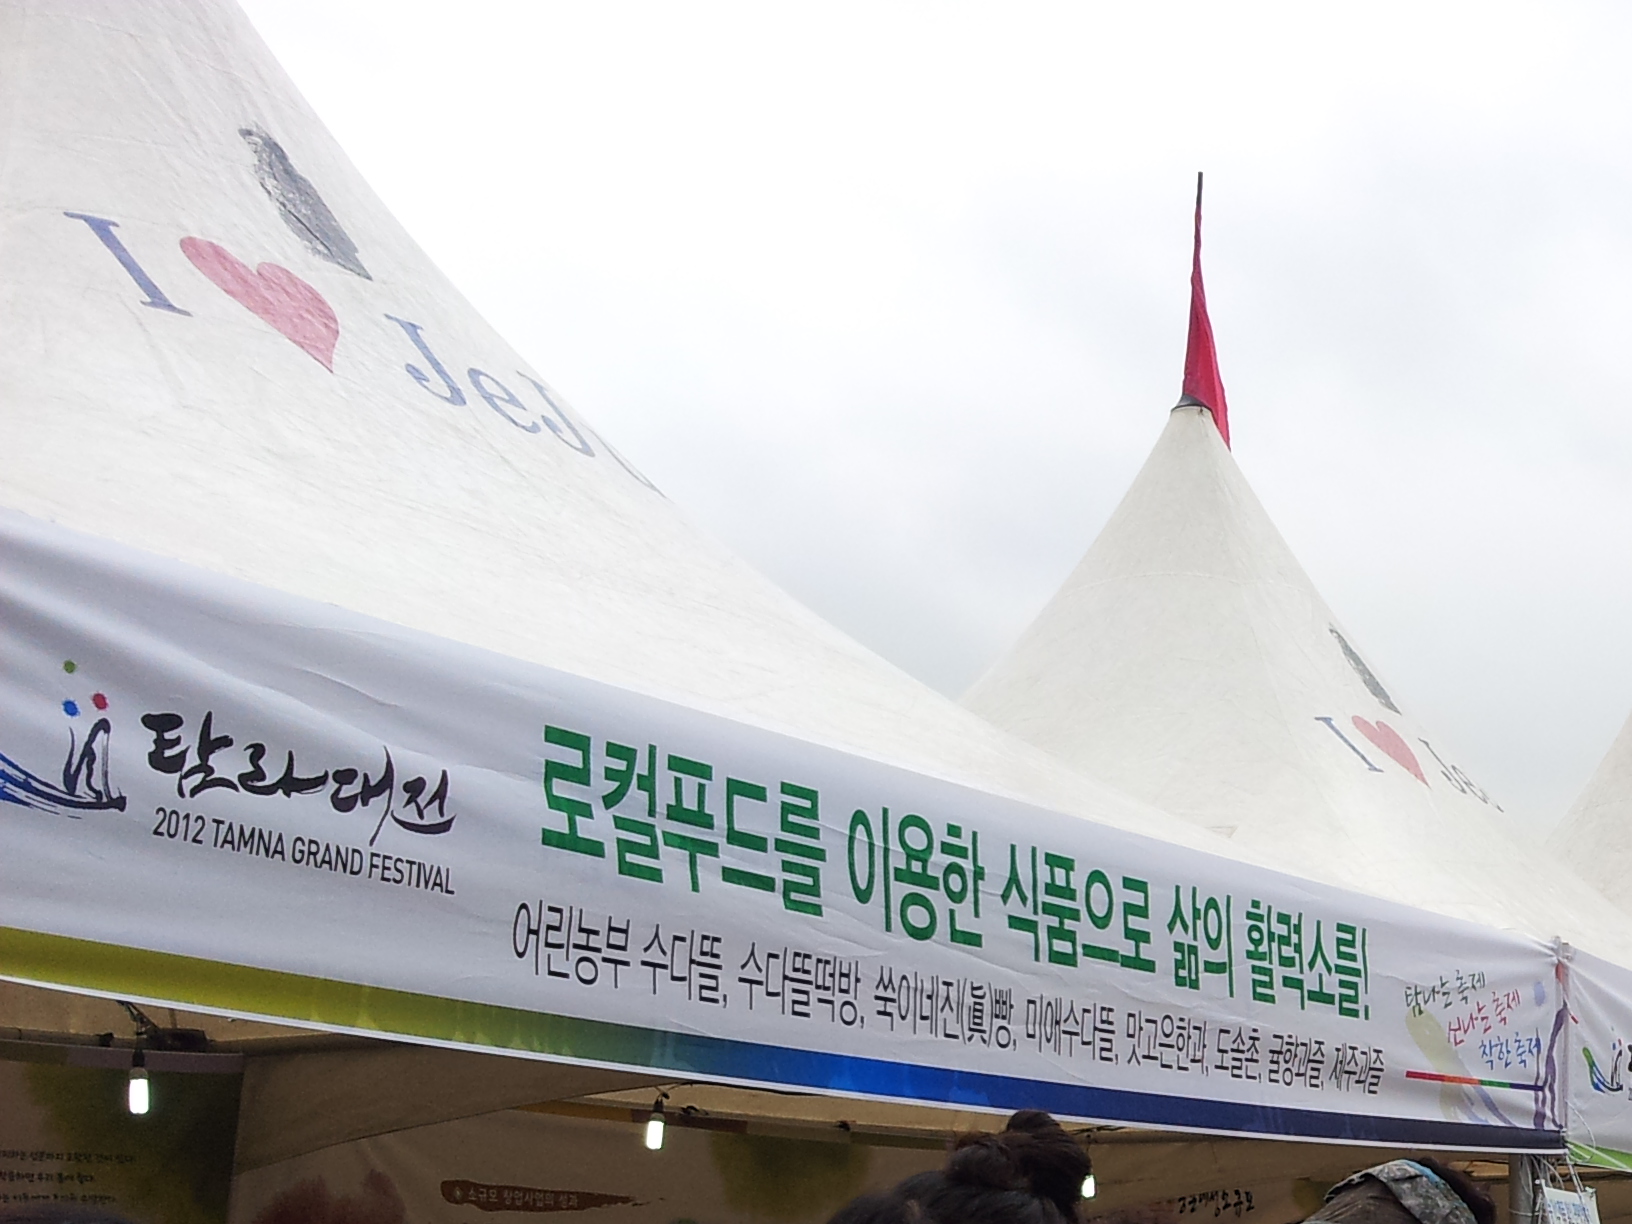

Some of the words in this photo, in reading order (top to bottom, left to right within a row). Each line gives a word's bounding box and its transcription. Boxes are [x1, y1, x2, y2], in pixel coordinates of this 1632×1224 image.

[63, 211, 192, 317] I
[152, 807, 205, 845] 2012
[212, 817, 287, 862] TAMNA
[291, 835, 363, 877] GRAND
[367, 847, 455, 895] FESTIVAL
[541, 724, 827, 918] 로컬푸드를
[847, 806, 985, 948] 이용한
[1002, 842, 1157, 975] 식품으로
[1167, 885, 1233, 990] 삶의
[1245, 900, 1370, 1021] 활력소를!
[513, 899, 630, 989] 어린농부
[641, 923, 728, 1008] 수다뜰,
[738, 941, 865, 1029] 수다뜰떡방,
[1026, 993, 1119, 1065] 미애수다뜰,
[1127, 1009, 1209, 1076] 맛고은한과,
[1329, 1042, 1384, 1095] 제주과즐
[1405, 975, 1453, 1017] 탐나는
[1456, 969, 1486, 1005] 축제
[1492, 989, 1521, 1026] 축제
[1479, 1036, 1512, 1070] 착한
